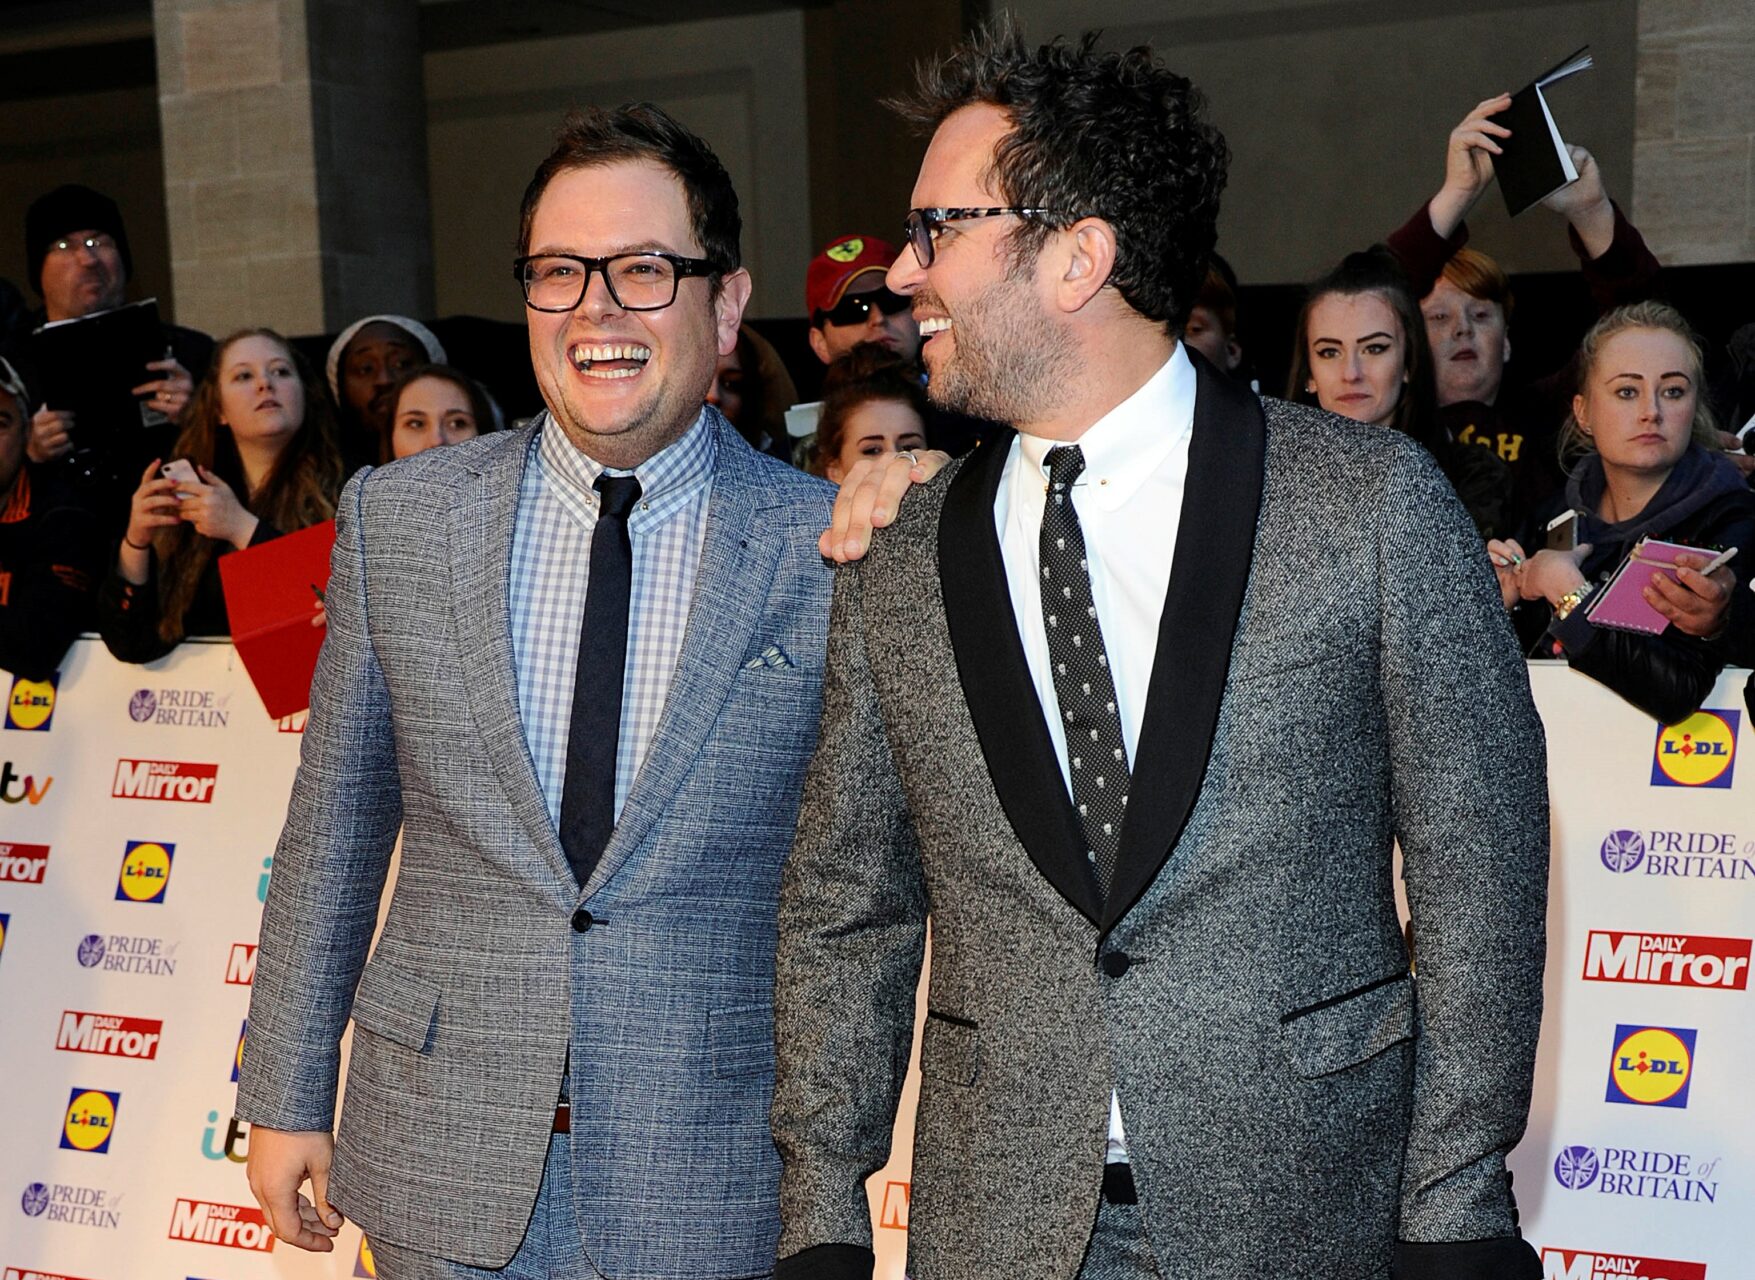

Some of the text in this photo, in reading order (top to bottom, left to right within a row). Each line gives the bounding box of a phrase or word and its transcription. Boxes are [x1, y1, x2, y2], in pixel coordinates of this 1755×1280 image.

[159, 690, 214, 708] PRIDE
[155, 708, 229, 727] BRITAIN
[114, 760, 214, 801] Mirror
[151, 763, 179, 775] DAILY
[0, 761, 53, 805] tv
[1649, 831, 1736, 855] PRIDE
[0, 856, 47, 881] ror
[108, 935, 163, 955] PRIDE
[1641, 936, 1687, 952] DAILY
[103, 955, 178, 976] BRITAIN
[1586, 933, 1747, 986] Mirror
[95, 1016, 124, 1029] DAILY
[58, 1013, 160, 1057] Mirror
[201, 1110, 249, 1163] it
[1602, 1148, 1721, 1178] PRIDE of
[52, 1184, 107, 1208] PRIDE
[1598, 1174, 1719, 1204] BRITAIN
[47, 1204, 121, 1229] BRITAIN
[208, 1205, 241, 1219] DAILY
[172, 1200, 273, 1249] Mirror
[1594, 1256, 1640, 1274] DAILY
